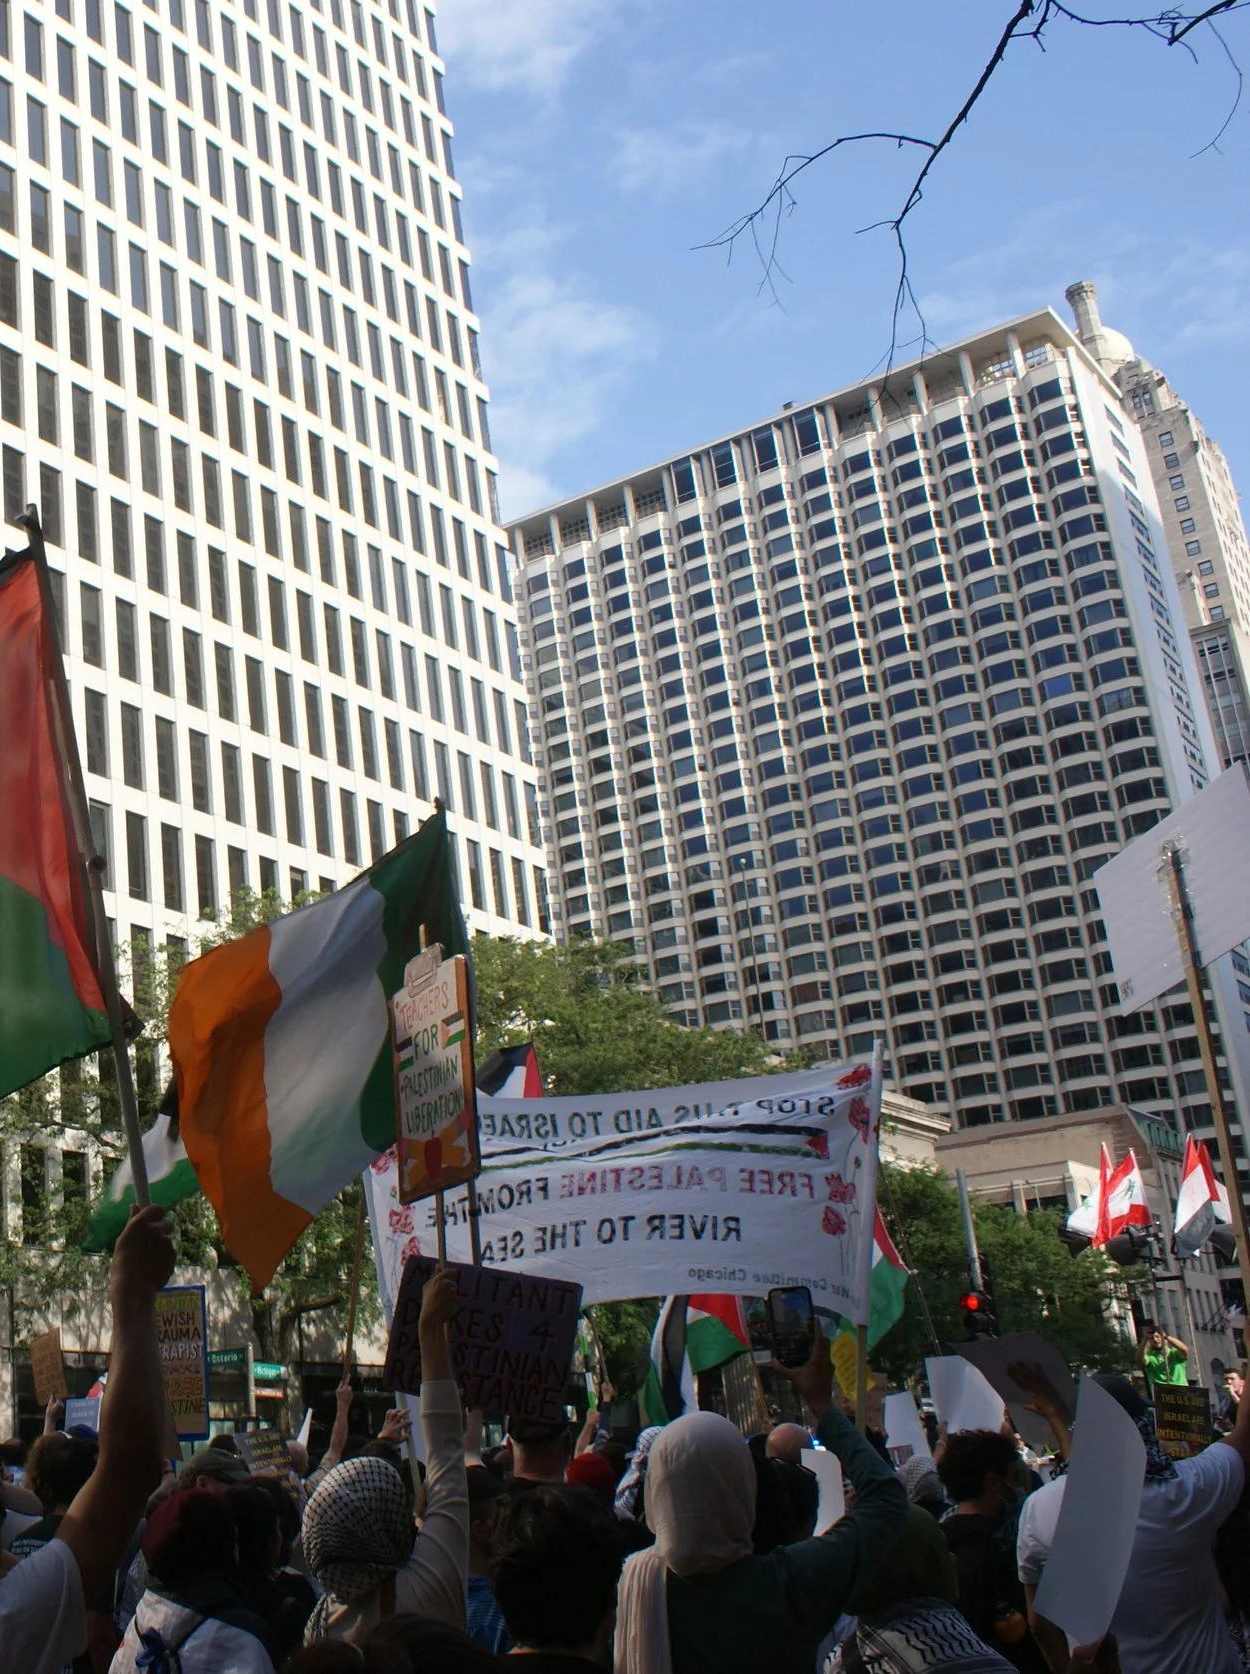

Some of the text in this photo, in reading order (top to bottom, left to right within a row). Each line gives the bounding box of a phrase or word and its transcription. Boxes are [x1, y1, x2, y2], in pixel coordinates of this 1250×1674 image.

[399, 981, 449, 1032] TEACHERS
[413, 1024, 439, 1061] FOR
[403, 1054, 458, 1101] PALESTINIAN
[406, 1087, 463, 1134] LIBERATION
[407, 1262, 575, 1316] MLITANT
[403, 1298, 556, 1353] DKES 4
[211, 1353, 238, 1363] Ontario
[396, 1333, 571, 1388] PASTINIAN
[388, 1357, 563, 1422] RESTANCE
